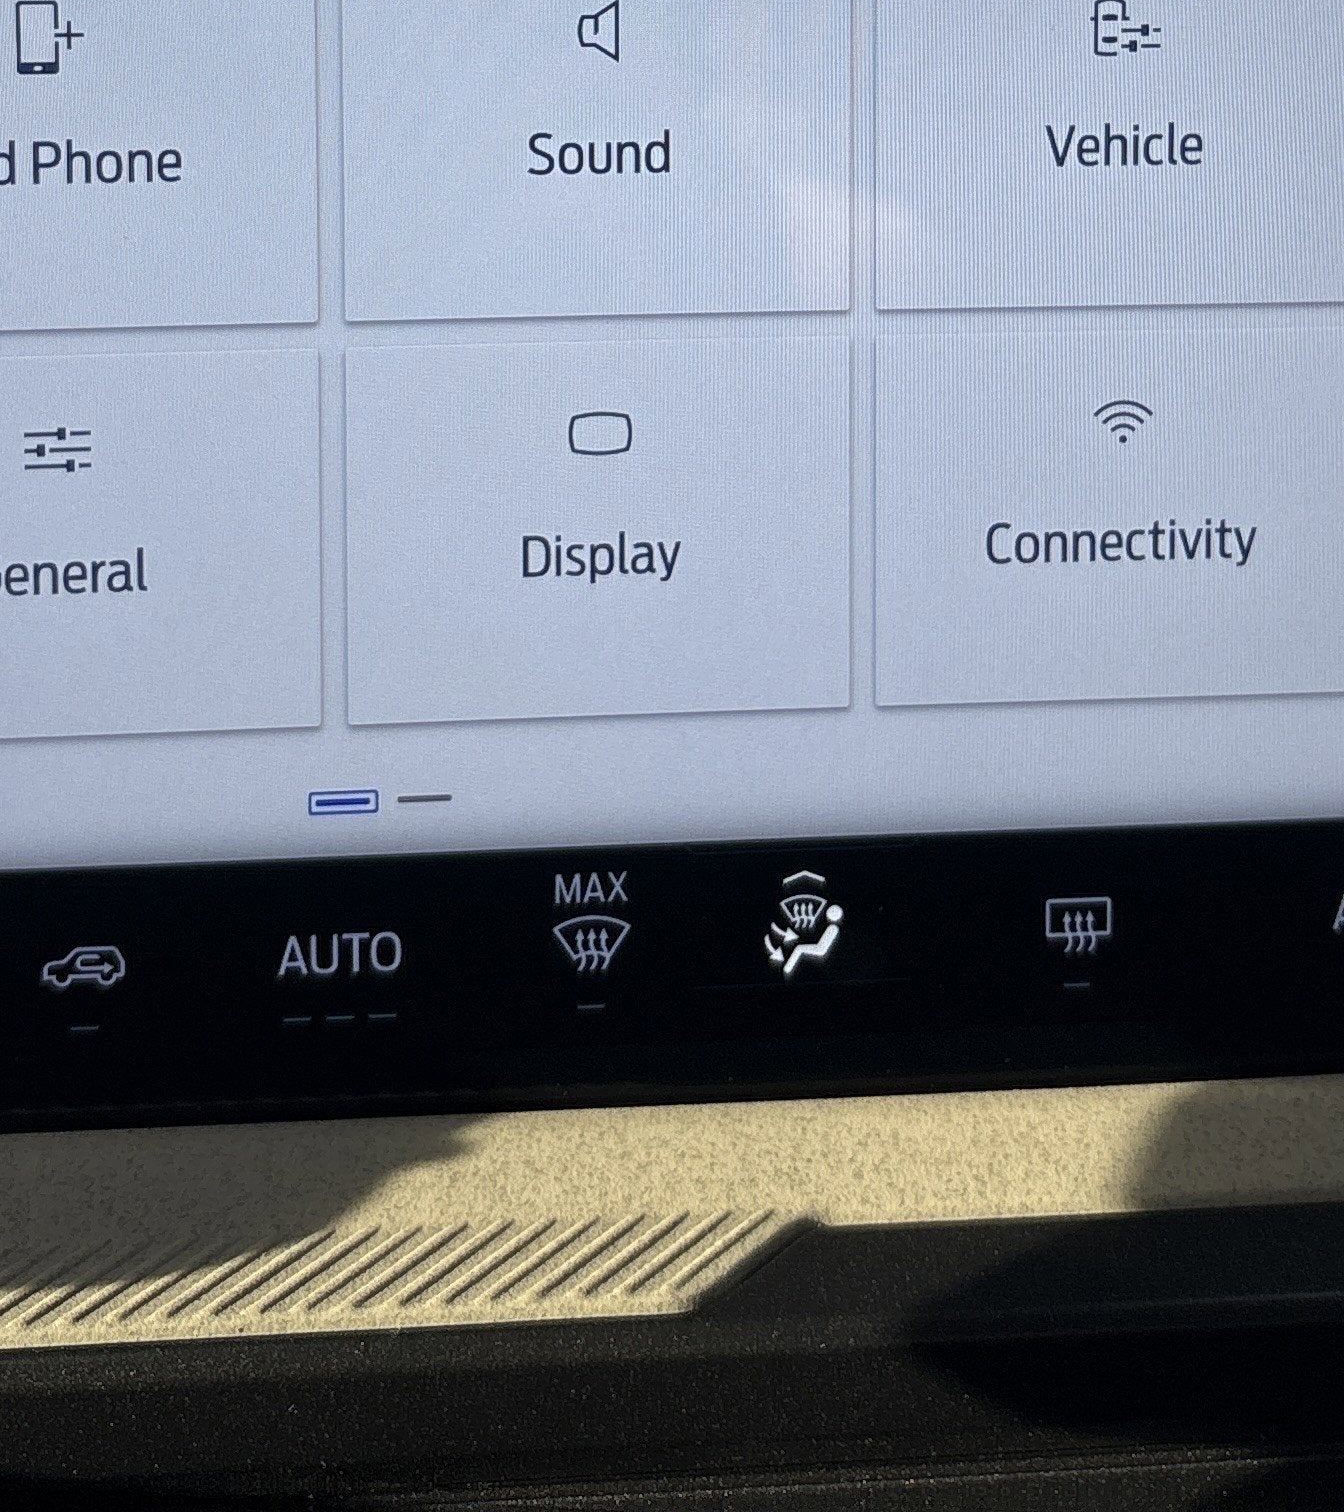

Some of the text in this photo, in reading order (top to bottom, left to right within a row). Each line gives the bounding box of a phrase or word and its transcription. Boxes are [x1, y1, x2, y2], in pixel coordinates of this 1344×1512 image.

[32, 139, 182, 185] Phone
[528, 129, 671, 176] Sound
[1045, 121, 1204, 168] Vehicle
[522, 531, 681, 585] Display
[986, 518, 1257, 567] Connectivity
[554, 871, 628, 904] MAX
[278, 931, 402, 977] AUTO
